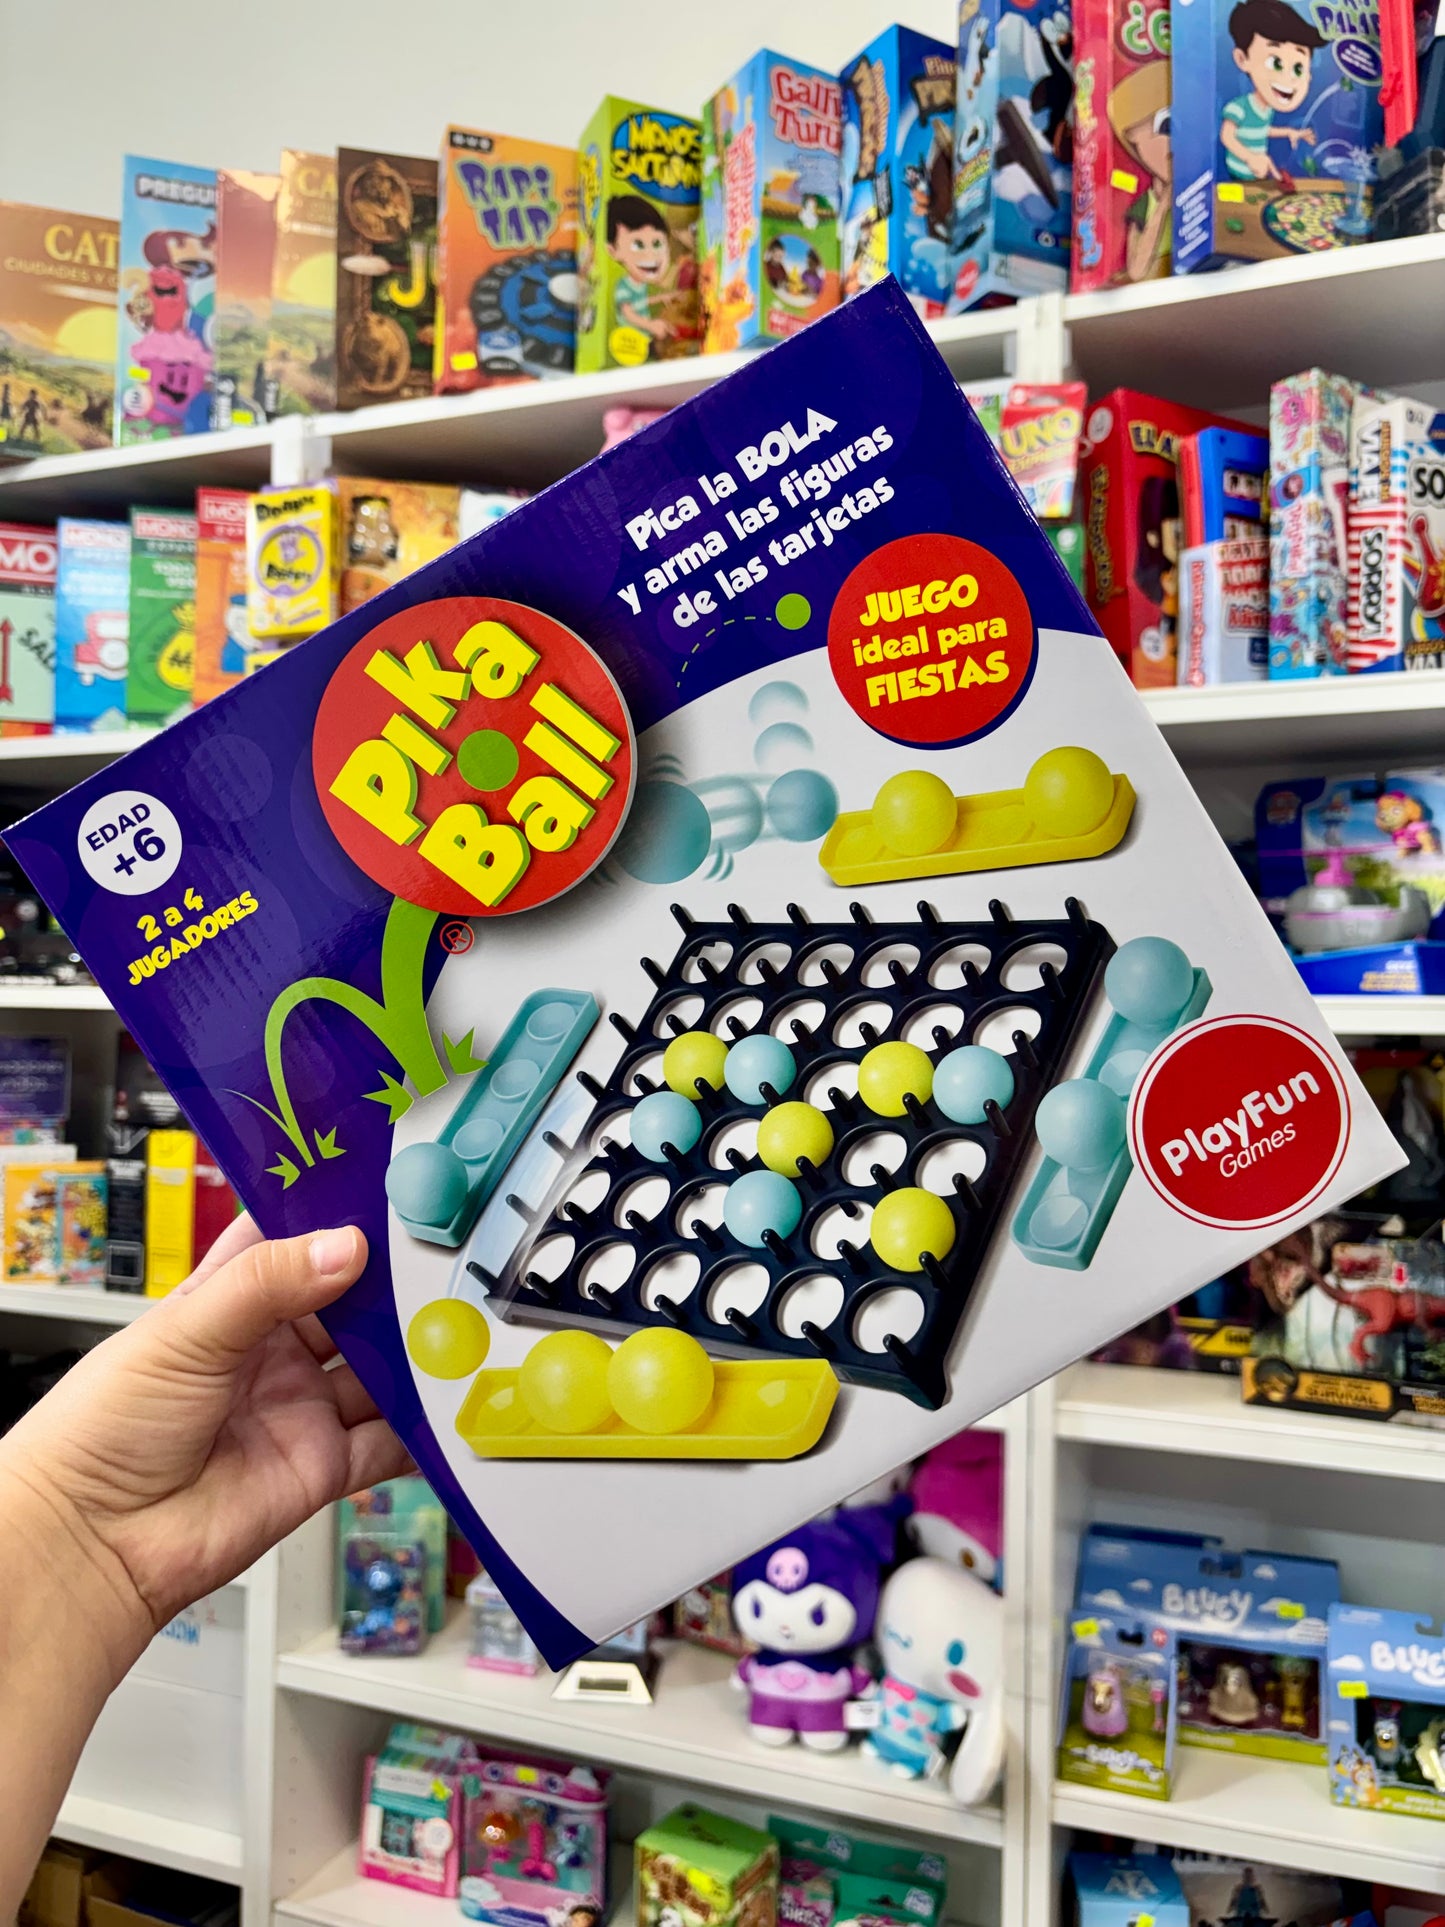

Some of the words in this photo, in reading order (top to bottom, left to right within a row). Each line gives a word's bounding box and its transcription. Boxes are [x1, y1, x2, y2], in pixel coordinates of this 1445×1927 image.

[138, 175, 217, 206] PREGU
[1001, 408, 1081, 458] UNO
[625, 495, 701, 552] Pica
[698, 471, 739, 506] la
[735, 407, 838, 482] BOLA
[643, 530, 729, 594] arma
[725, 496, 780, 541] las
[779, 425, 894, 508] figuras
[673, 589, 718, 628] de
[714, 556, 769, 600] las
[768, 476, 895, 566] tarjetas
[859, 574, 979, 627] JUEGO
[852, 625, 930, 667] ideal
[937, 617, 1008, 656] para
[865, 650, 1010, 708] FIESTAS
[417, 682, 622, 908] Ball
[85, 803, 151, 852] EDAD
[113, 827, 166, 877] +6
[127, 890, 259, 986] JUGADORES
[136, 914, 163, 943] 2
[163, 906, 184, 928] a
[183, 887, 204, 912] 4
[1160, 1070, 1321, 1177] PlayFun
[1219, 1122, 1296, 1178] Games
